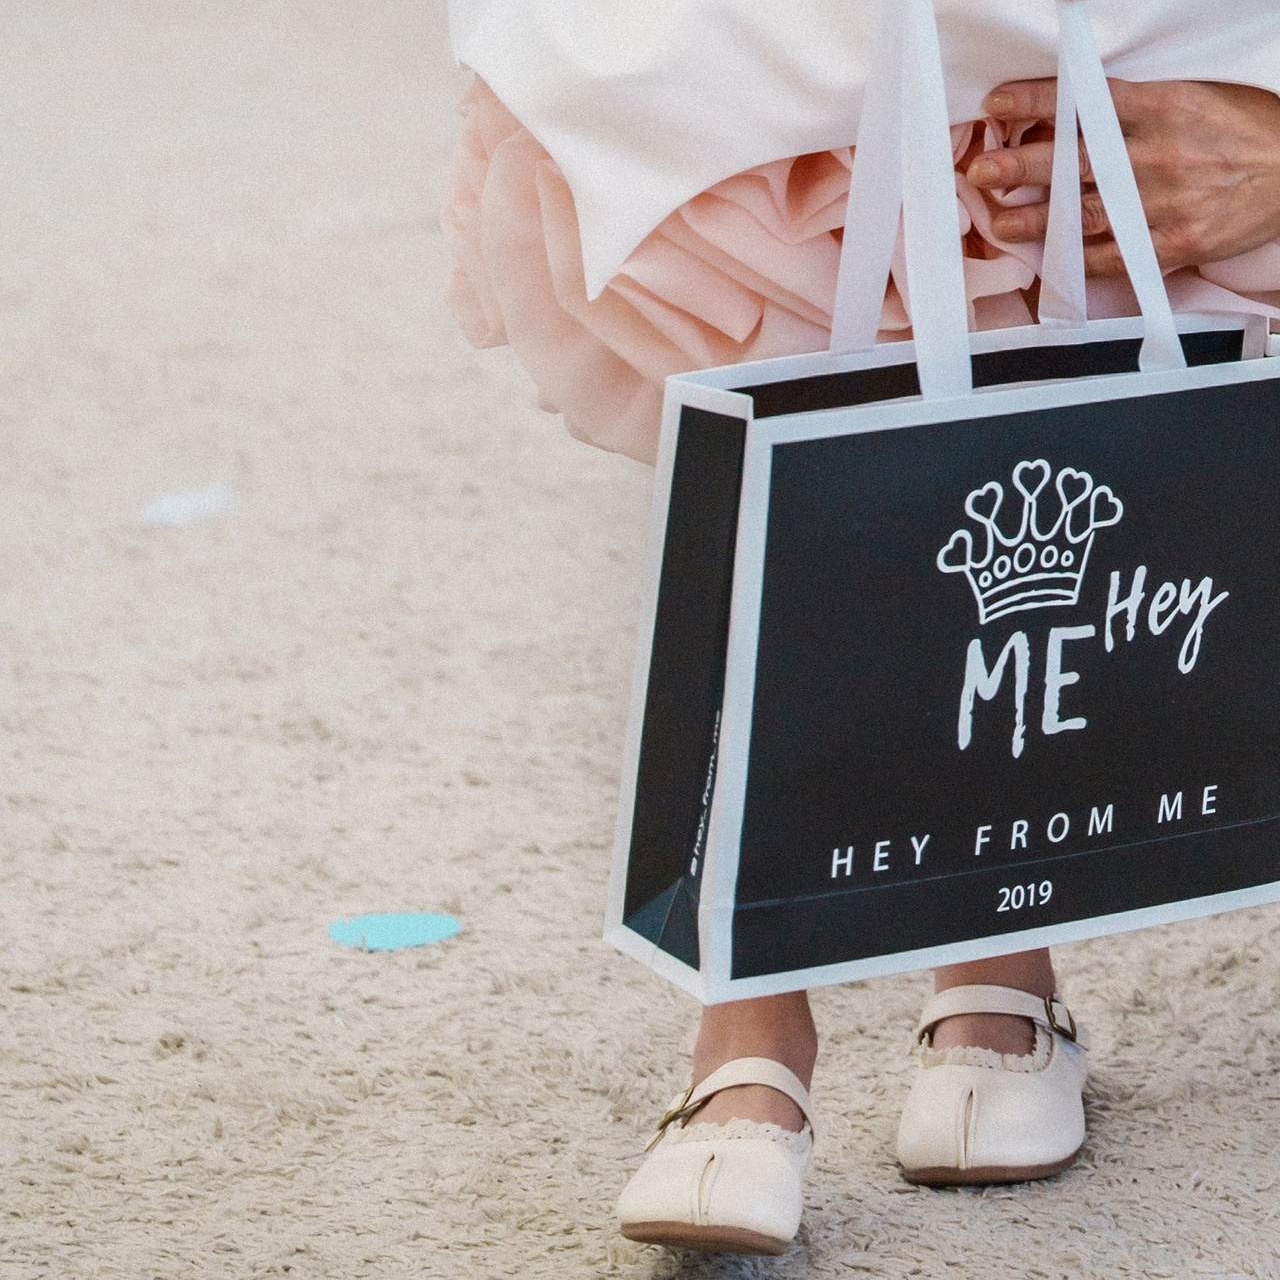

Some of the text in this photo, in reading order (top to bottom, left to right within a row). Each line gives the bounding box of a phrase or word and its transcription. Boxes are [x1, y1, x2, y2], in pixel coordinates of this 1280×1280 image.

[1104, 565, 1231, 675] Hey
[957, 625, 1096, 759] ME
[831, 784, 1219, 878] HEY FROM ME
[996, 880, 1053, 913] 2019
